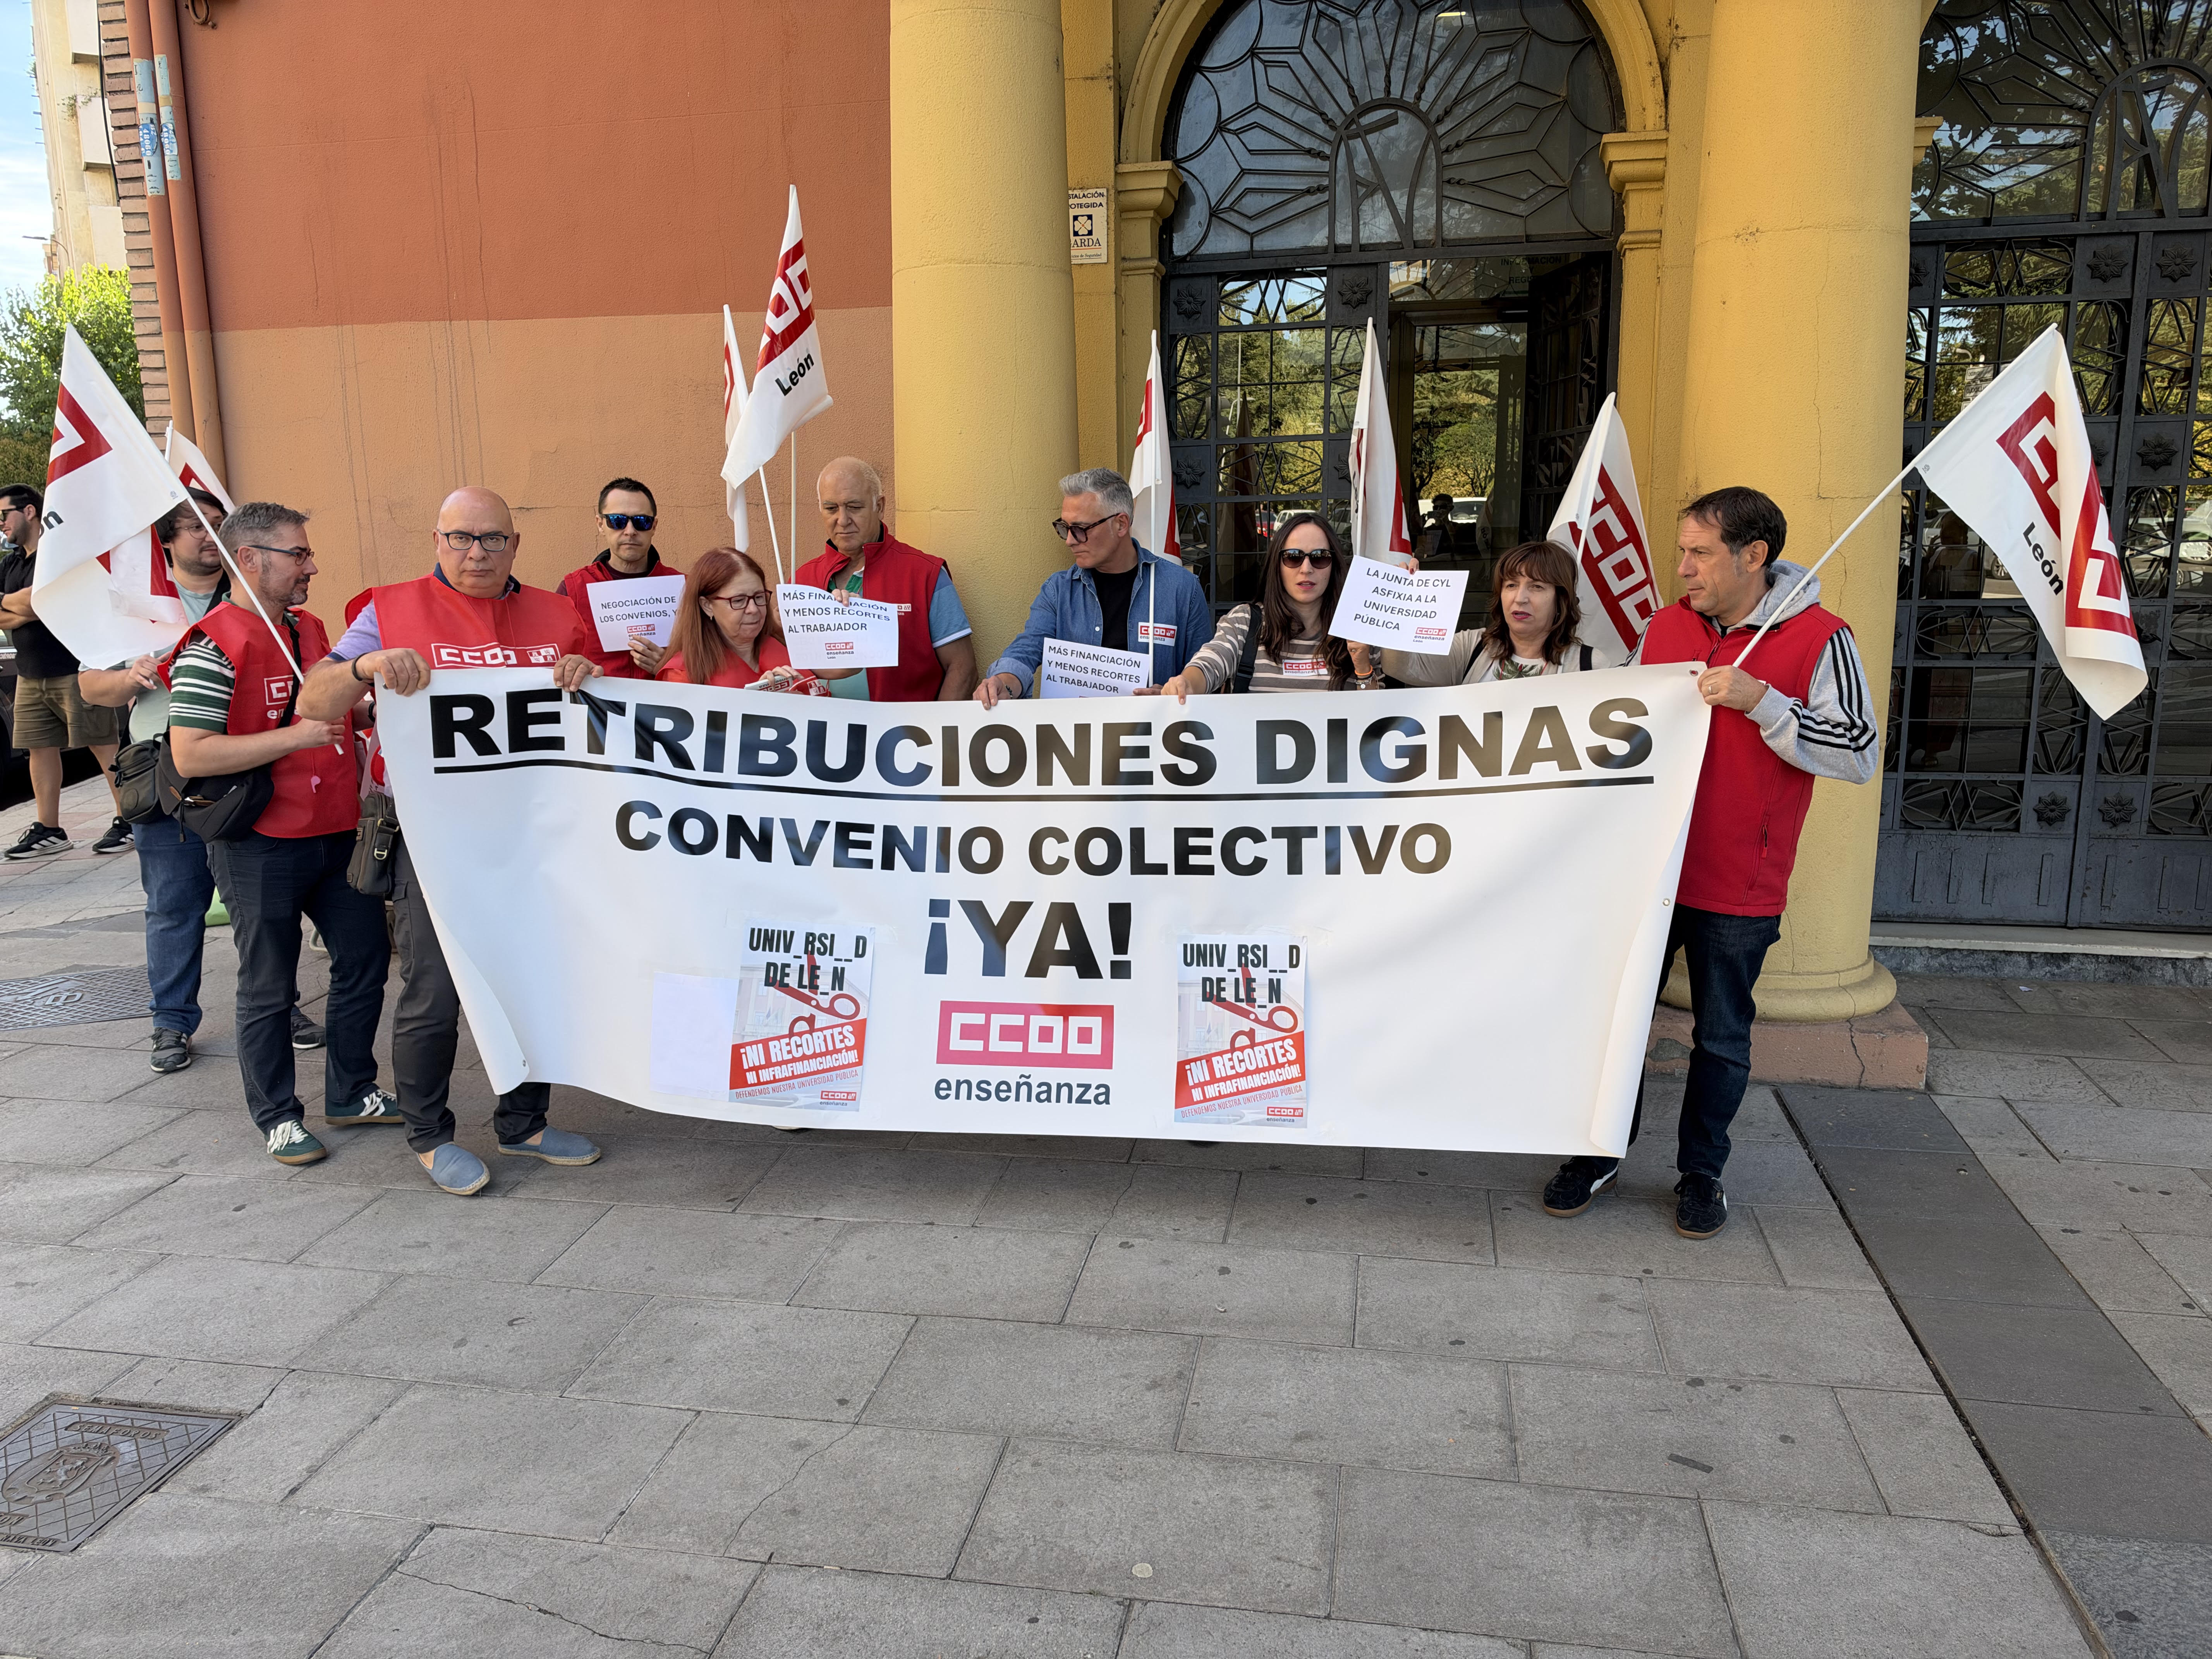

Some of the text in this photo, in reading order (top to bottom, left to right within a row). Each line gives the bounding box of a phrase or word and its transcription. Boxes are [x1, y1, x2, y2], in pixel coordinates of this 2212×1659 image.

[1068, 191, 1104, 199] STALACIÓN
[1070, 238, 1101, 248] ARDA
[1501, 256, 1562, 266] INFOMACION
[775, 353, 814, 397] León
[2023, 522, 2064, 596] León
[1367, 568, 1379, 578] LA
[1381, 572, 1413, 586] JUNTA
[601, 596, 662, 610] NEGOCIACIÓN
[783, 590, 887, 611] MÁS FINAIACIÓN
[1372, 586, 1412, 602] ASFIXIA
[616, 610, 670, 620] CONVENIOS,
[793, 608, 830, 617] MENOS
[834, 608, 890, 621] RECORTES
[1364, 600, 1436, 618] UNIVERSIDAD
[800, 623, 867, 632] TRABAJADOR
[1354, 613, 1400, 630] PÚBLICA
[1048, 646, 1140, 668] MÁS FINANCIACIÓN
[1055, 661, 1089, 674] MENOS
[1091, 668, 1140, 683] RECORTES
[1046, 674, 1119, 694] AL TRABAJADOR
[430, 689, 1653, 787] RETRIBUCIONES DIGNAS
[615, 800, 1452, 876] CONVENIO COLECTIVO
[924, 898, 1132, 979] ¡YA!
[764, 962, 791, 988] DE
[1202, 977, 1226, 1002] DE
[949, 1012, 1102, 1054] CCOO
[740, 1025, 855, 1069] ¡NI RECORTES
[746, 1049, 859, 1084] NI INFRAFINANCIACIÓN!
[1185, 1039, 1297, 1086] ¡NI RECORTES
[735, 1070, 858, 1099] DEFENDEMOS NUESTRA UNIVERSIDAD PÚBLICA
[934, 1074, 1111, 1105] enseñanza
[1192, 1063, 1302, 1102] NI INFRAFINANCIACIÓN!
[1181, 1084, 1303, 1118] DEFENDEMOS NUESTRA UNIVERSIDAD PÚBLICA
[72, 1423, 161, 1439] SEMAFOROS
